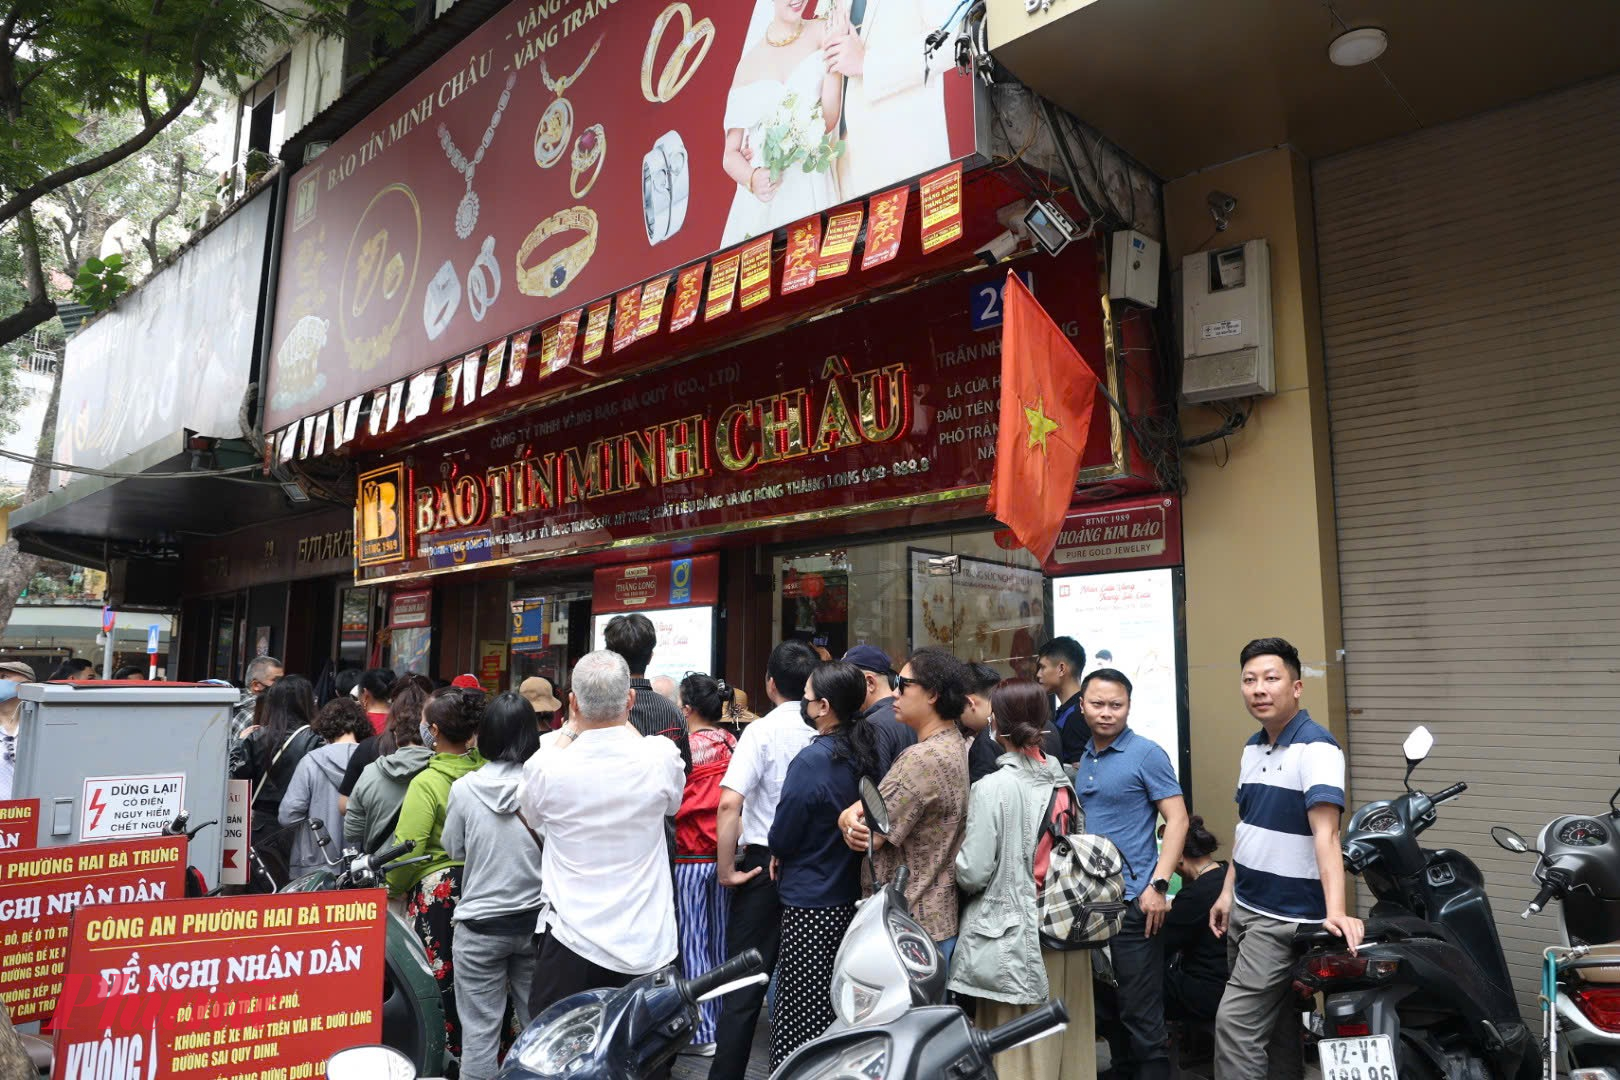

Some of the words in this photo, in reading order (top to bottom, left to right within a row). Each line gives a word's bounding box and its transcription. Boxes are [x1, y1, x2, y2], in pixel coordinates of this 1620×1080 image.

[514, 25, 558, 70] VÀNG
[562, 0, 618, 37] TRAN
[327, 154, 356, 191] BẢO
[360, 130, 386, 167] TÍN
[388, 92, 435, 146] MINH
[438, 48, 494, 108] CHÂU
[980, 286, 1004, 320] 2
[937, 343, 978, 369] TRẦN
[981, 339, 1002, 358] NH
[947, 381, 963, 399] LÀ
[965, 377, 989, 394] CỬA
[520, 427, 531, 443] TY
[534, 423, 560, 438] TNHH
[709, 363, 741, 386] LTD)
[937, 404, 962, 423] ĐẦU
[965, 399, 994, 417] TIÊN
[414, 463, 480, 535] BẢO
[486, 443, 557, 519] TÍN
[563, 414, 705, 504] MINH
[715, 355, 908, 472] CHÂU
[939, 426, 966, 446] PHỐ
[978, 445, 997, 460] NĂ
[1085, 516, 1111, 526] BTMC
[1111, 513, 1131, 523] 1989
[1058, 525, 1103, 546] HOÀNG
[1103, 525, 1129, 541] KIM
[1131, 518, 1161, 538] BẢO
[1066, 549, 1087, 559] PURE
[1088, 547, 1112, 557] GOLD
[1114, 543, 1152, 555] JEWELRY
[638, 580, 656, 591] LONG
[111, 782, 149, 796] DỪNG
[153, 782, 178, 796] LẠI!
[0, 805, 32, 820] RƯNG
[114, 809, 143, 820] NGUY
[146, 805, 171, 817] HIỂM
[123, 798, 138, 807] CÓ
[110, 820, 138, 832] CHẾT
[141, 818, 174, 830] NGƯỜ
[7, 857, 73, 879] PHƯỜNG
[78, 855, 104, 872] HAI
[108, 850, 128, 868] BÀ
[132, 846, 179, 864] TRƯNG
[0, 896, 42, 924] GHỊ
[46, 883, 114, 916] NHÂN
[119, 878, 167, 903] DÂN
[58, 926, 69, 938] TR
[86, 916, 145, 942] CÔNG
[149, 915, 177, 937] AN
[182, 908, 259, 935] PHƯỜNG
[263, 907, 294, 929] HAI
[297, 903, 321, 926] BÀ
[325, 900, 378, 924] TRƯNG
[2, 951, 34, 967] KHÔNG
[49, 947, 60, 960] XE
[34, 964, 50, 978] SAI
[51, 962, 65, 976] QU
[97, 951, 142, 999] ĐỀ
[146, 957, 222, 994] NGHỊ
[226, 944, 305, 985] NHÂN
[308, 939, 364, 976] DÂN
[33, 982, 49, 999] XẾP
[51, 980, 63, 995] HÀ
[175, 1031, 211, 1051] KHÔNG
[228, 1027, 241, 1043] XE
[243, 1022, 266, 1041] MÁY
[267, 1017, 291, 1037] TRÊN
[350, 1009, 373, 1026] LÒNG
[65, 1025, 144, 1080] KHÔNG
[171, 1051, 210, 1073] ĐƯỜNG
[211, 1049, 229, 1067] SAI
[231, 1046, 251, 1065] QUY
[253, 1042, 280, 1062] ĐỊNH.
[1330, 1039, 1380, 1065] 12-V1
[314, 1058, 327, 1076] LÒ
